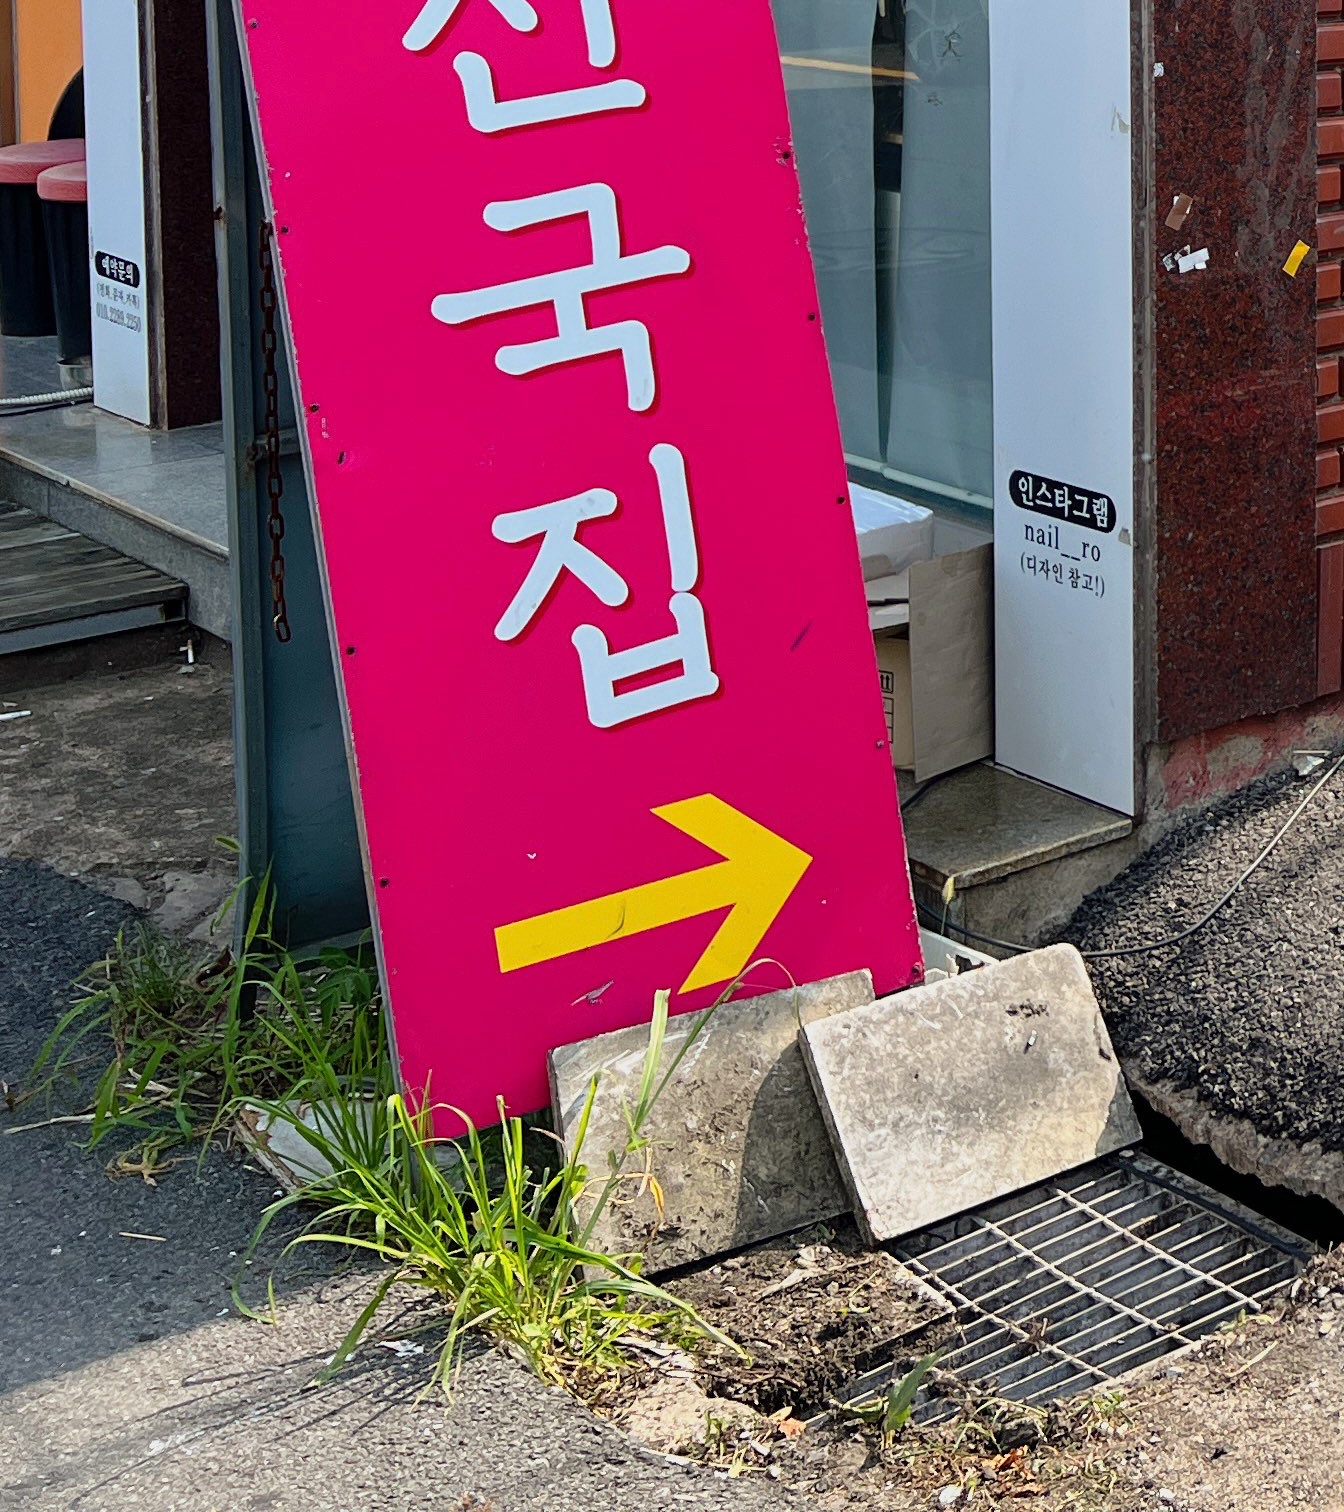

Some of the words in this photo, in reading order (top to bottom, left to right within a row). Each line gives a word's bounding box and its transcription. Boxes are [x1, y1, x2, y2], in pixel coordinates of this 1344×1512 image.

[101, 255, 134, 284] 예약문의
[1018, 475, 1108, 528] 인스타그램
[1020, 551, 1064, 585] (디자인
[1067, 566, 1105, 599] 참고!)
